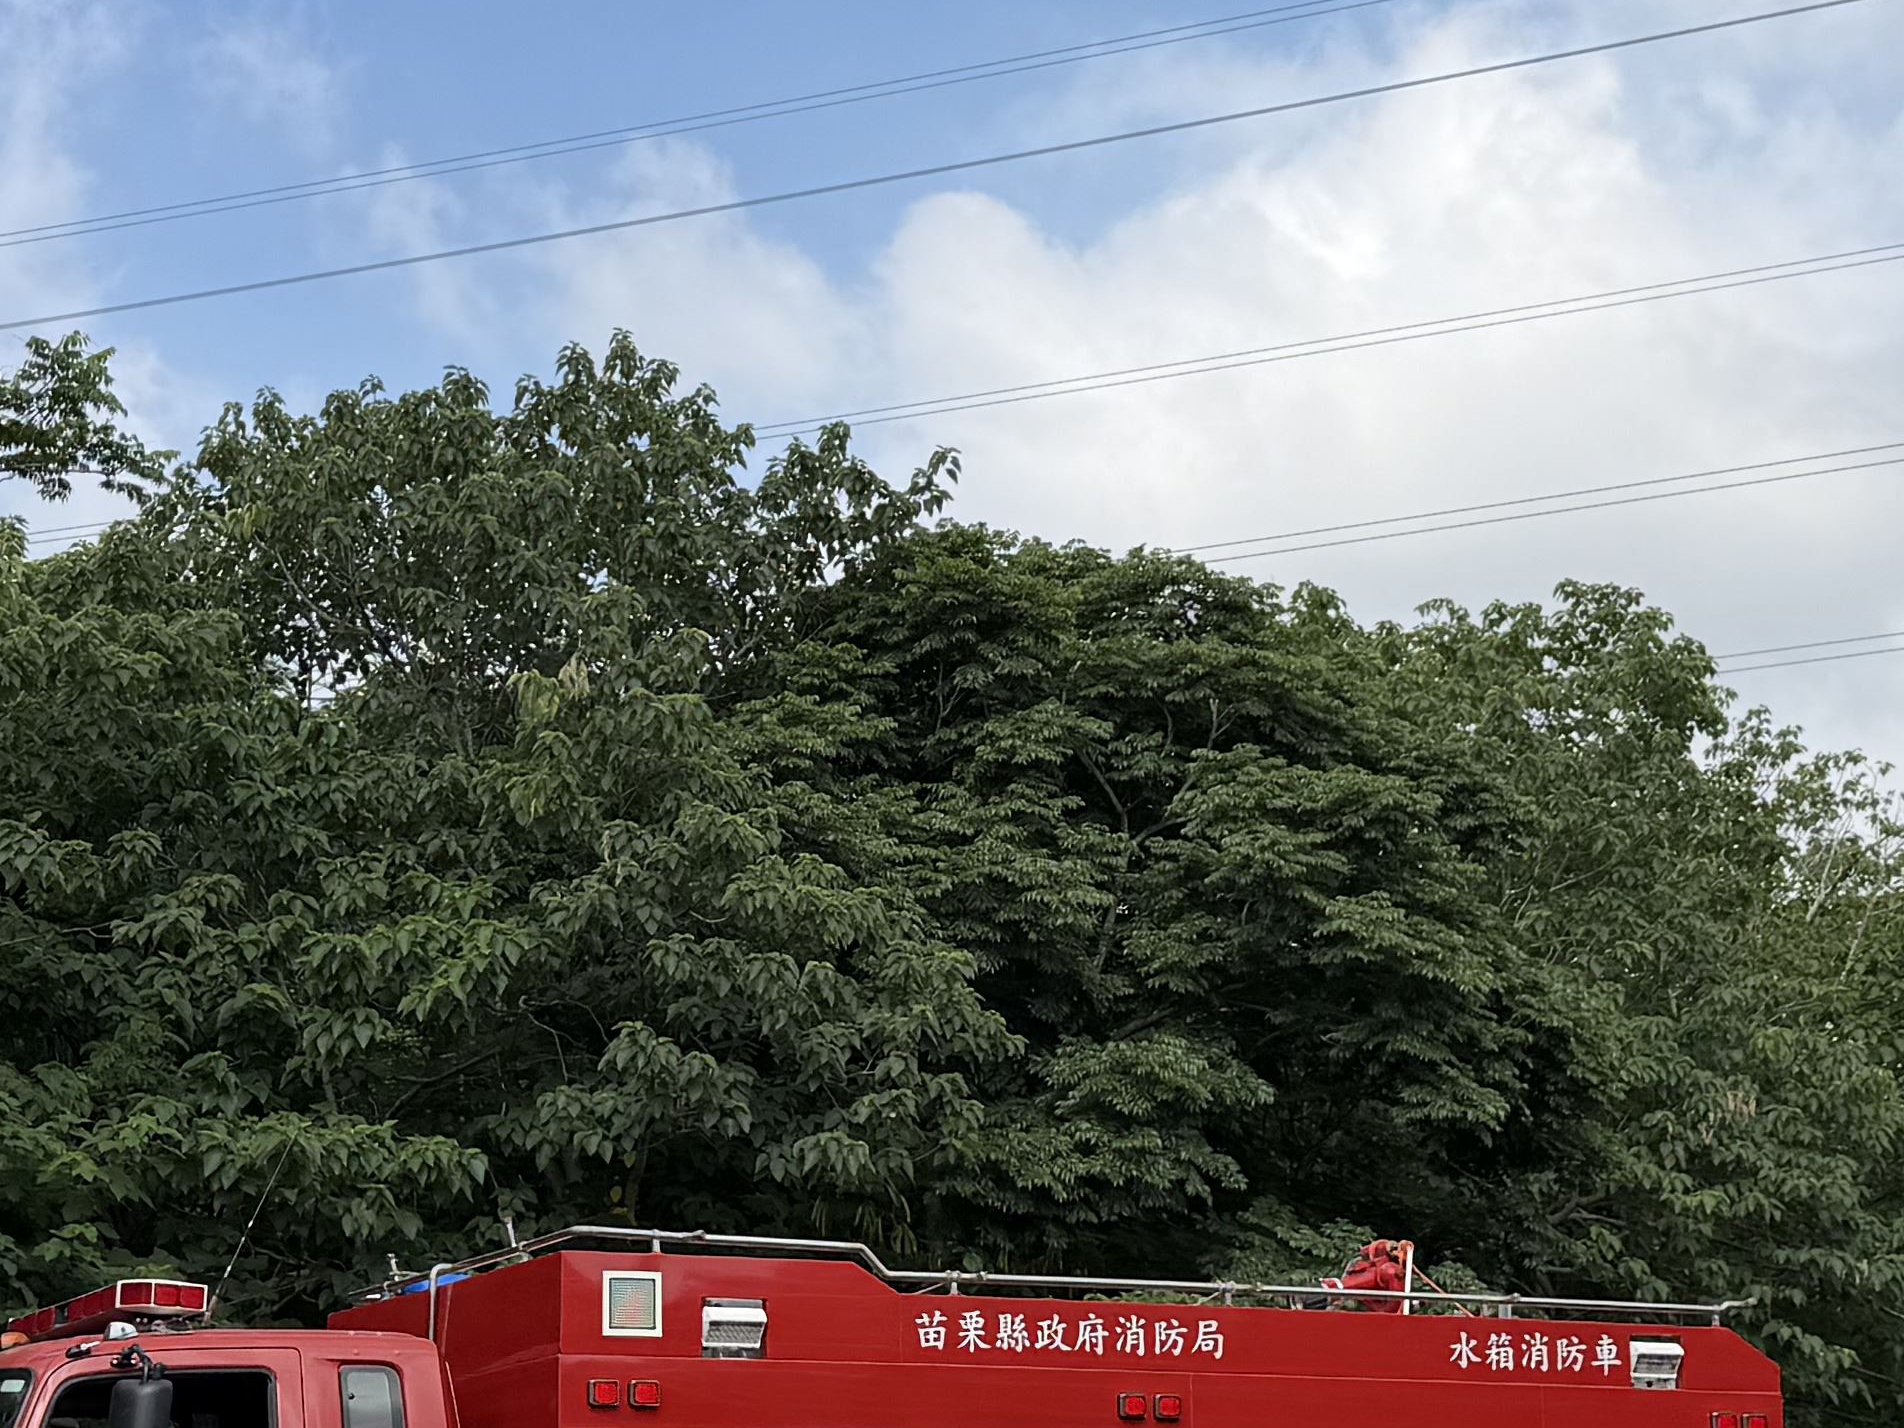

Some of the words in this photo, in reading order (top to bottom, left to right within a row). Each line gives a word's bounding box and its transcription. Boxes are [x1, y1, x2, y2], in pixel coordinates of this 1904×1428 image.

[914, 1309, 1225, 1360] 苗栗縣政府消防局
[1448, 1331, 1623, 1377] 水箱消防車
